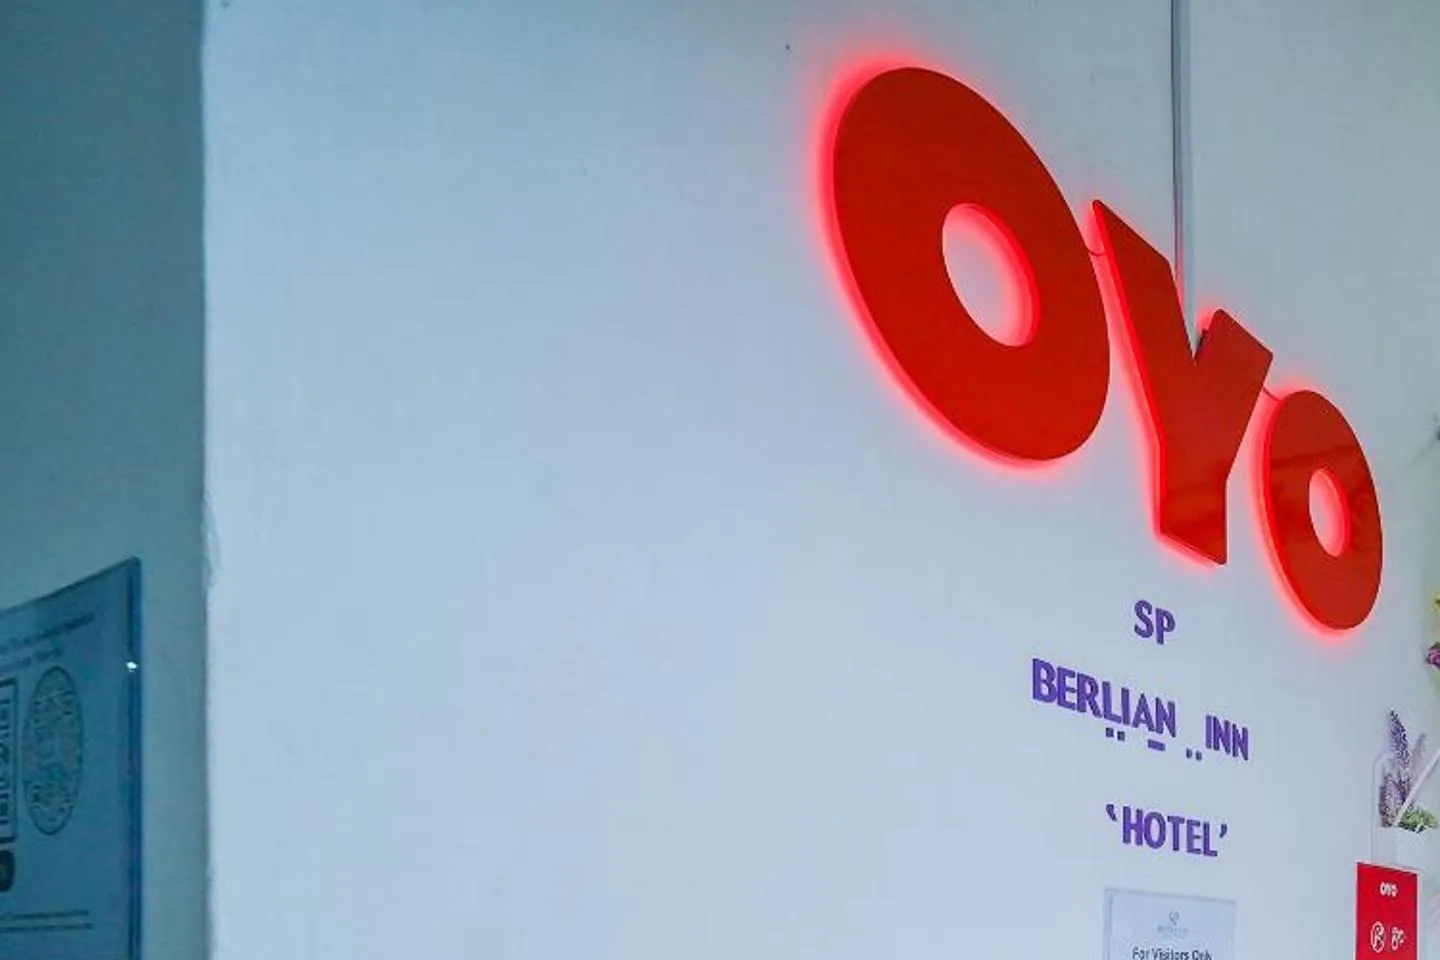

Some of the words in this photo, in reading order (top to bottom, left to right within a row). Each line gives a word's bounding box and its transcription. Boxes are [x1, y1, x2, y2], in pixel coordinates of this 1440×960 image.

[831, 66, 1384, 632] OYO
[1133, 599, 1176, 645] SP
[1031, 657, 1177, 738] BERLIAN
[1204, 714, 1250, 761] INN
[1132, 946, 1150, 960] For
